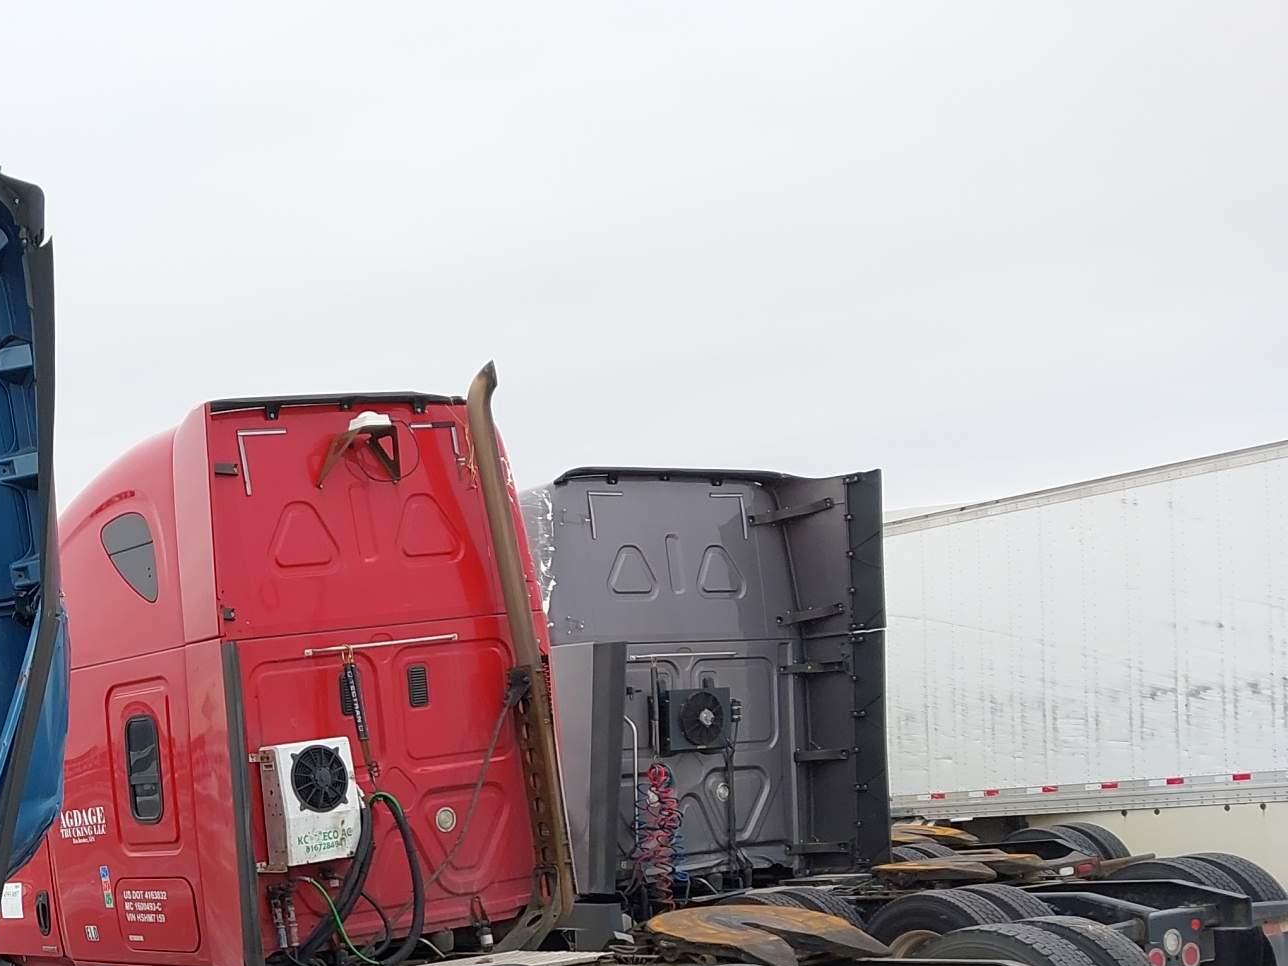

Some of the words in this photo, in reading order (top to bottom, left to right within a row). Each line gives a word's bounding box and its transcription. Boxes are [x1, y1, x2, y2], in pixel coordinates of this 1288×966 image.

[60, 823, 93, 840] TRUCKING
[92, 821, 107, 834] LLC
[132, 890, 144, 900] DOT
